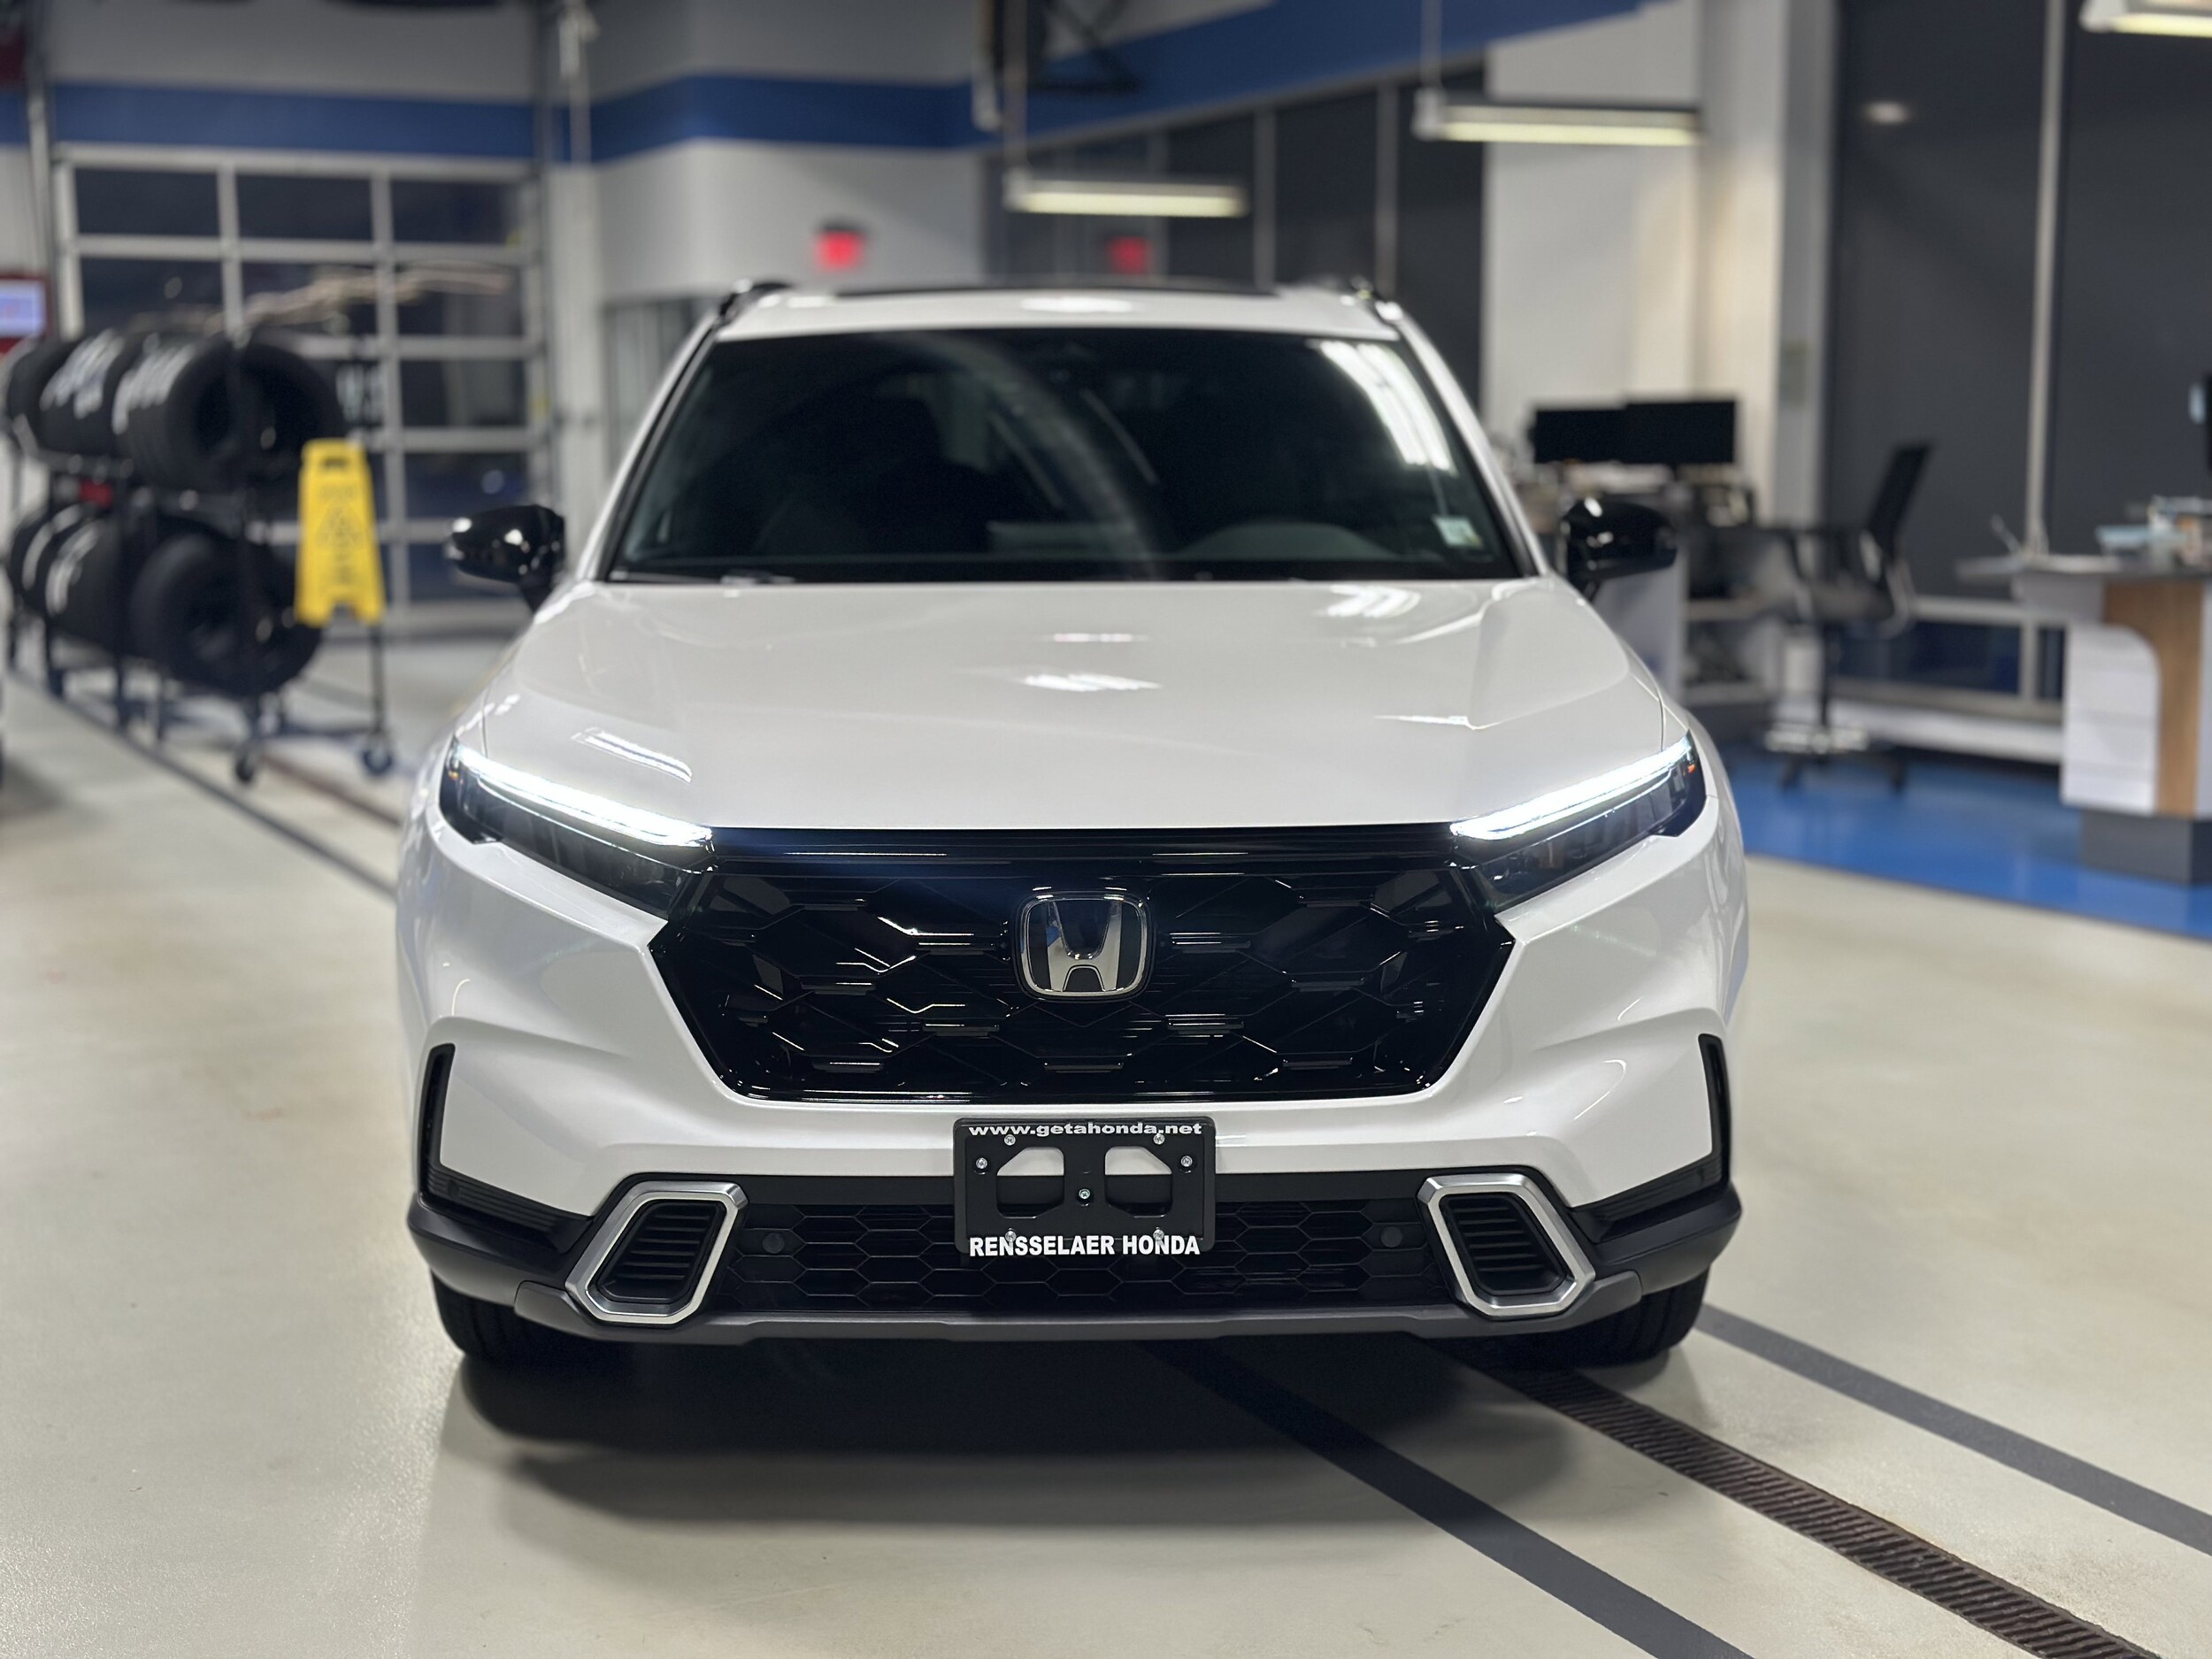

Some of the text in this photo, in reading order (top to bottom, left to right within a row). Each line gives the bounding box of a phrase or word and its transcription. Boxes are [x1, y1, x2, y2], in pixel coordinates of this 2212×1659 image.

[969, 1121, 1202, 1137] www.getahonda.net
[970, 1234, 1200, 1256] RENSSELAER HONDA
